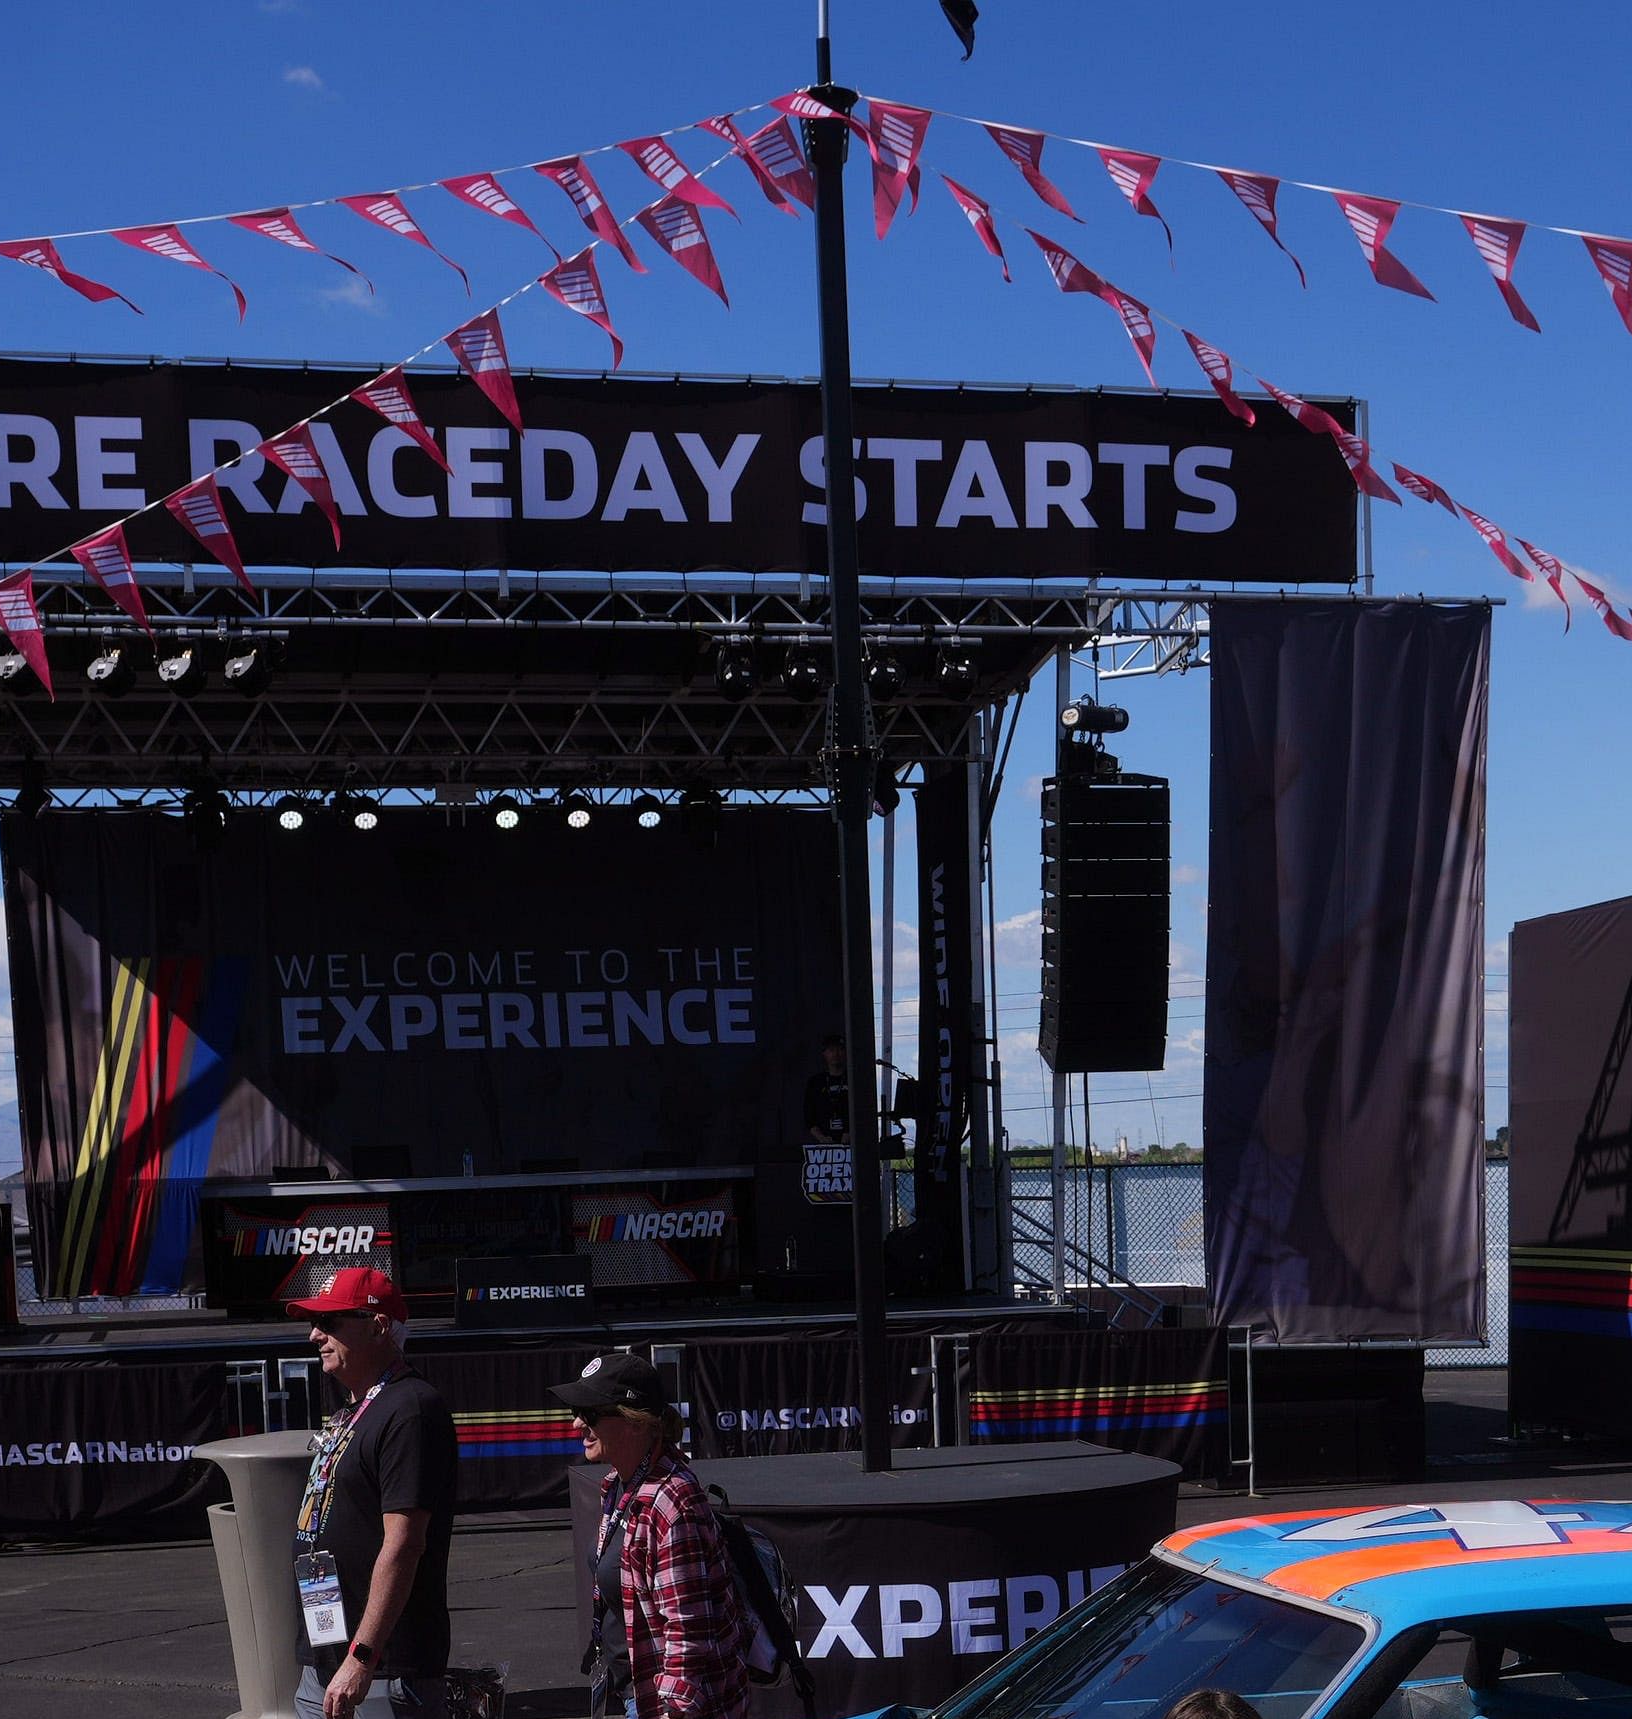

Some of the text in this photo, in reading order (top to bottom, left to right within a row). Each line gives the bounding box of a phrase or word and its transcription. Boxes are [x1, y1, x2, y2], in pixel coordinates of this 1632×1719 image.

[187, 416, 762, 523] RACEDAY
[798, 434, 1238, 534] STARTS
[275, 947, 755, 991] WELCOME TO THE
[283, 987, 756, 1055] EXPERIENCE
[265, 1225, 375, 1256] NASCAR
[623, 1210, 726, 1241] NASCAR
[489, 1284, 586, 1301] EXPERIENCE
[716, 1404, 929, 1432] @NASCARNion
